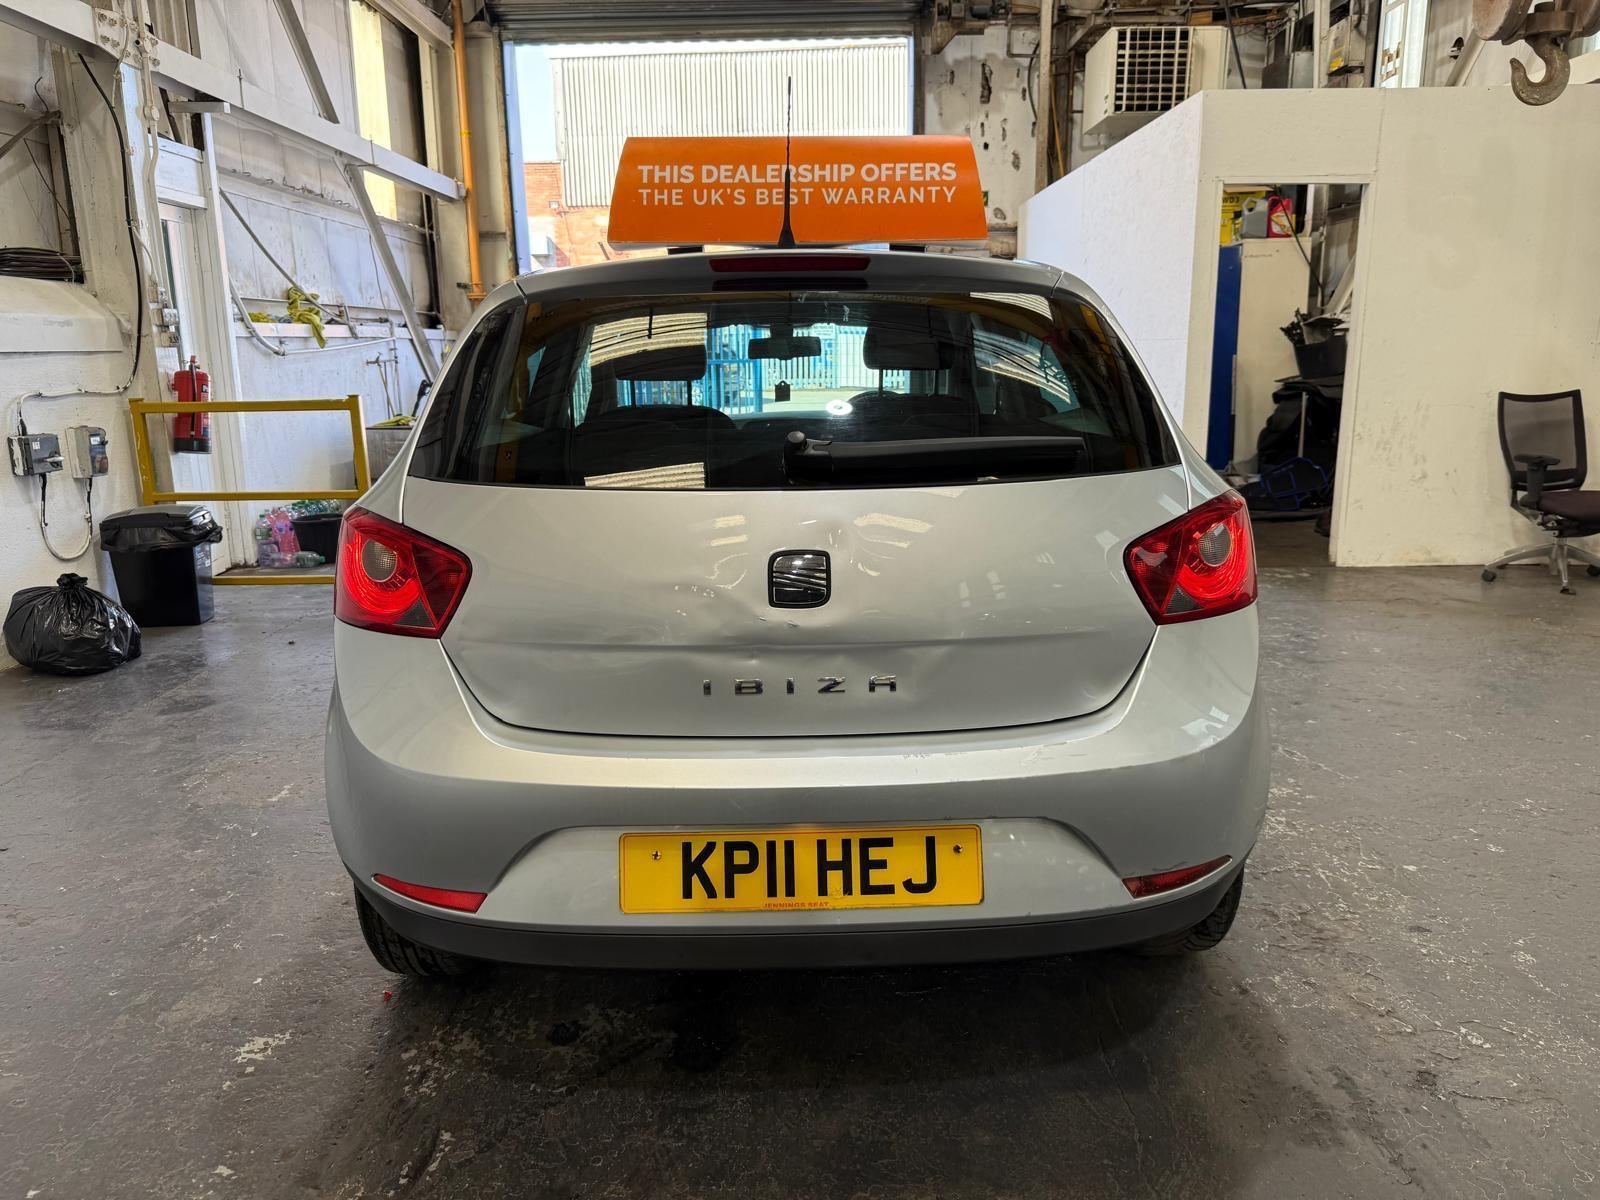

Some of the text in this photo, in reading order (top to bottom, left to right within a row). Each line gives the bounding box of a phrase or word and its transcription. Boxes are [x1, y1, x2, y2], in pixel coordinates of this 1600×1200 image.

[638, 162, 957, 184] THIS DEALERSHIP OFFERS
[638, 186, 957, 206] THE UK'S BEST WARRANTY
[703, 675, 897, 696] IBIZA
[681, 835, 937, 900] KP11 HEJ
